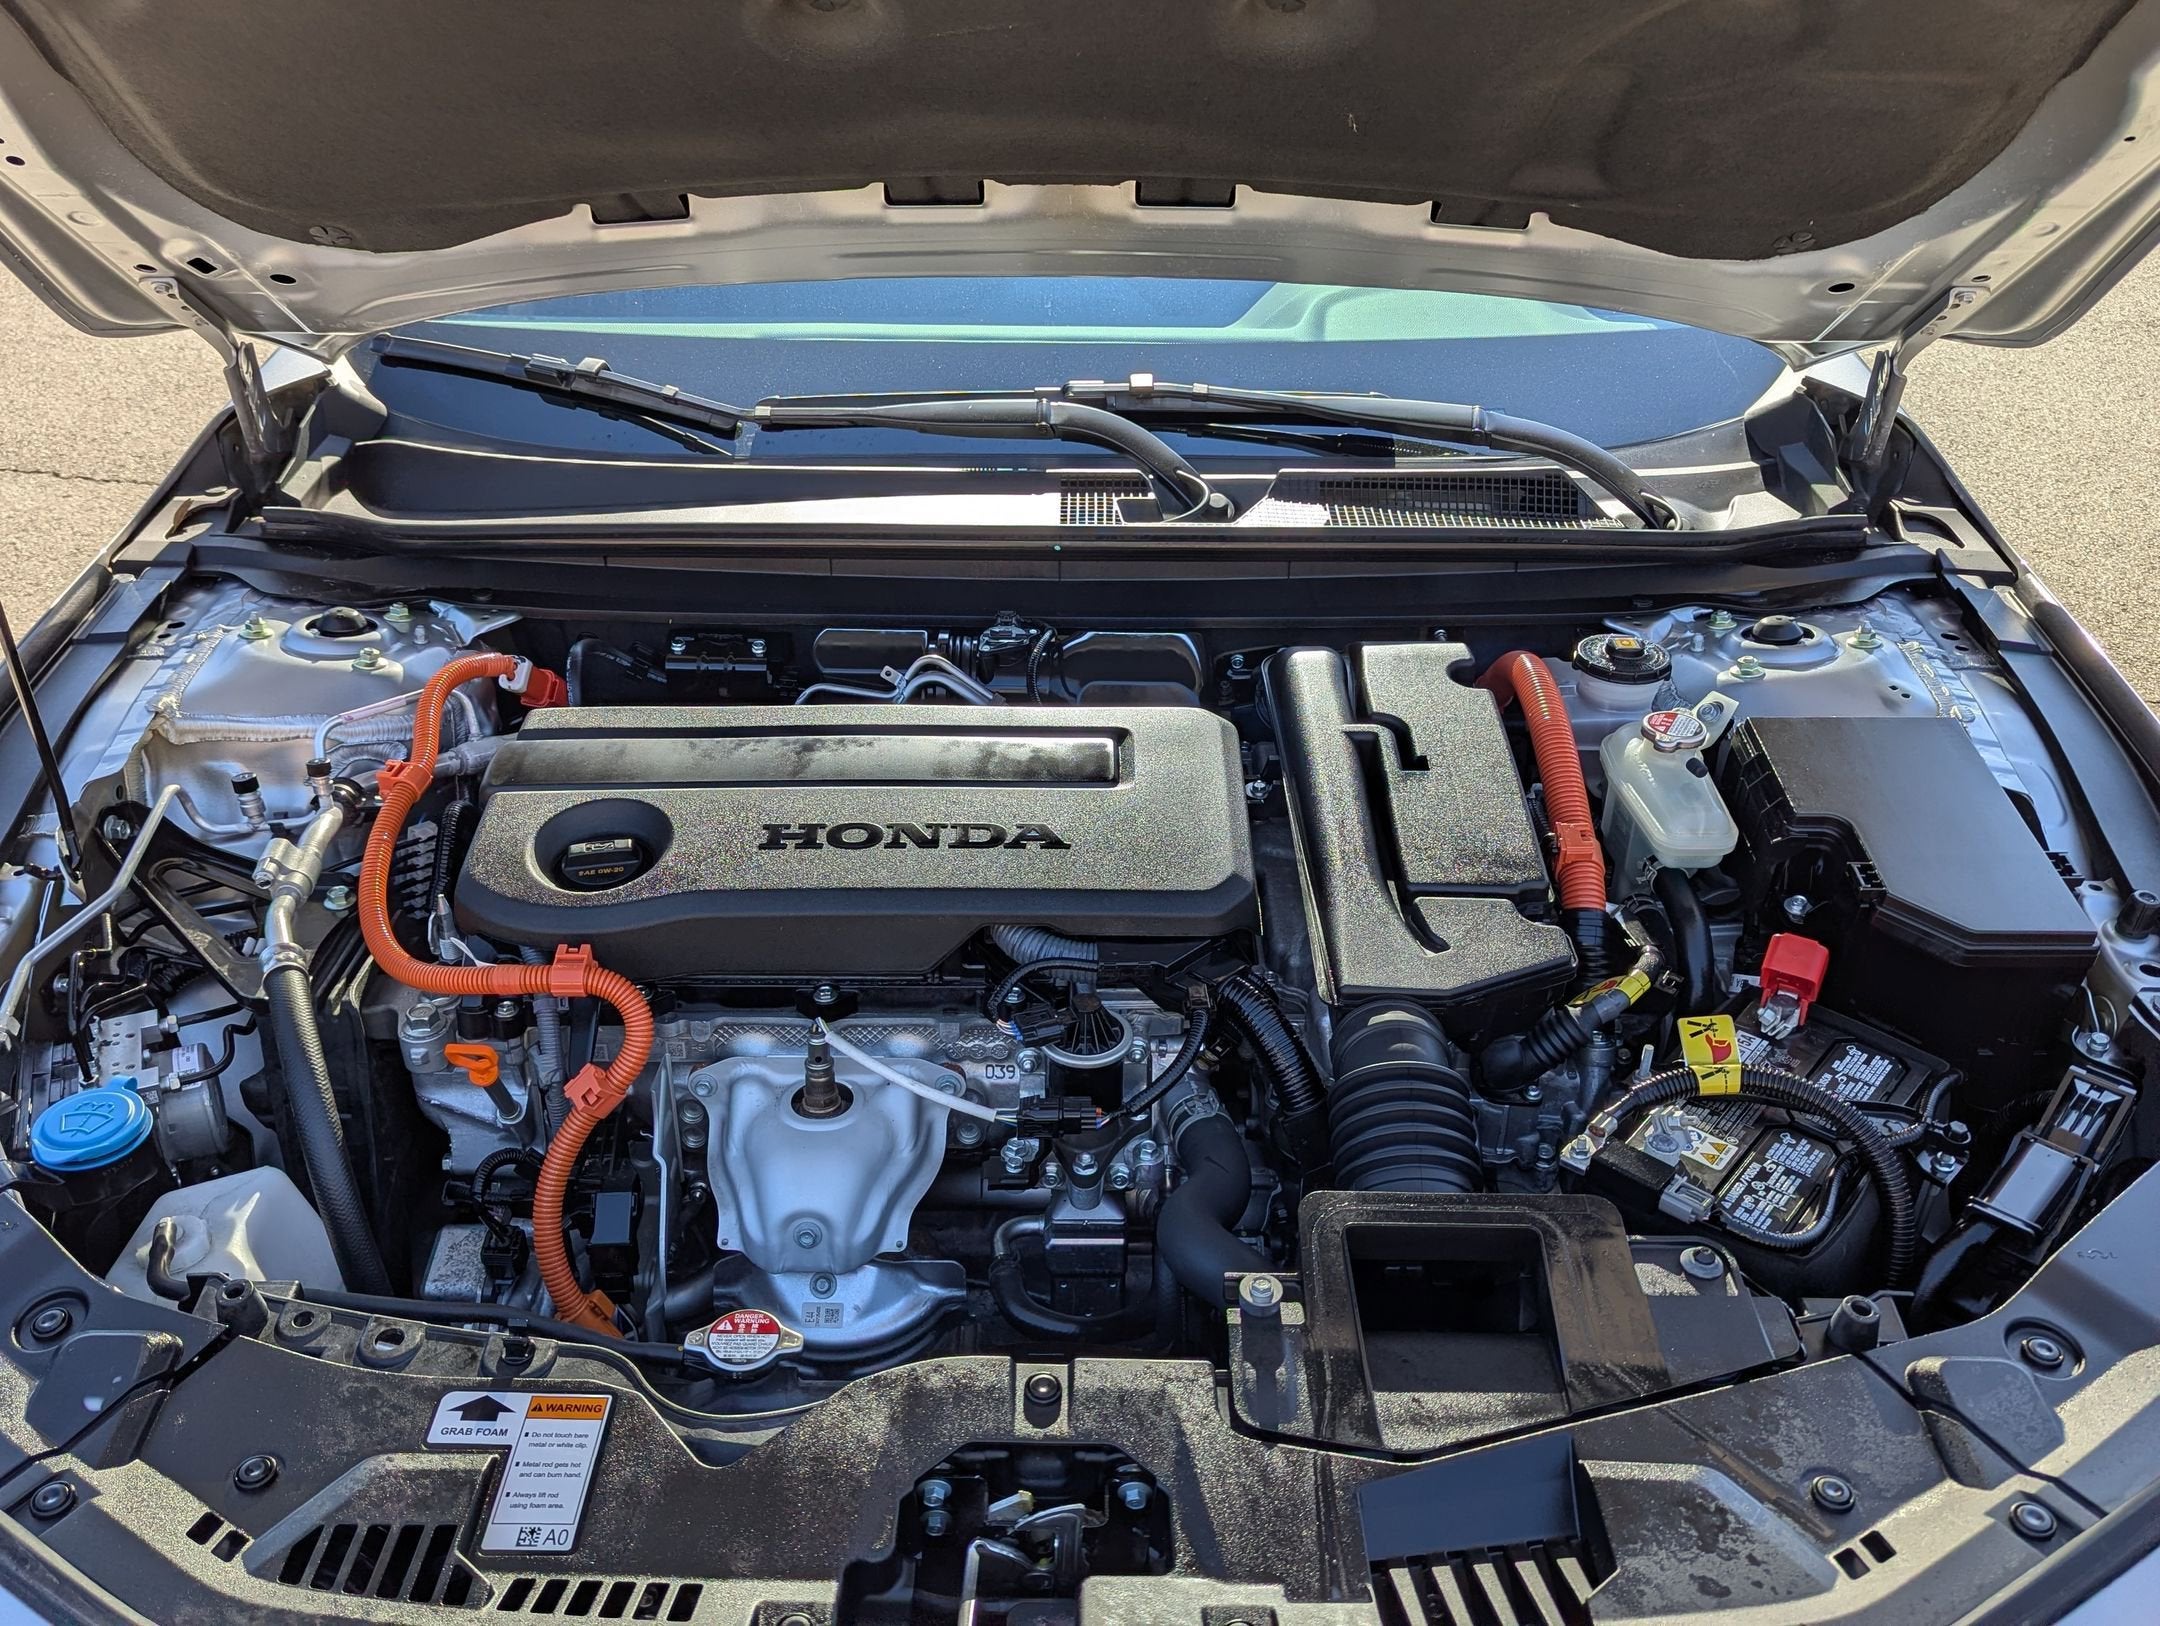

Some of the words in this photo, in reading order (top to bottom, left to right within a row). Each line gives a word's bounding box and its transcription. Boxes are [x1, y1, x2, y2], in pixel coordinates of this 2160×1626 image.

[758, 822, 1072, 850] HONDA
[598, 866, 624, 874] 0W-20
[985, 1064, 1015, 1079] 039
[545, 1403, 602, 1413] WARNING
[440, 1427, 473, 1436] GRAB
[475, 1428, 509, 1437] FOAM
[542, 1529, 569, 1546] A0
